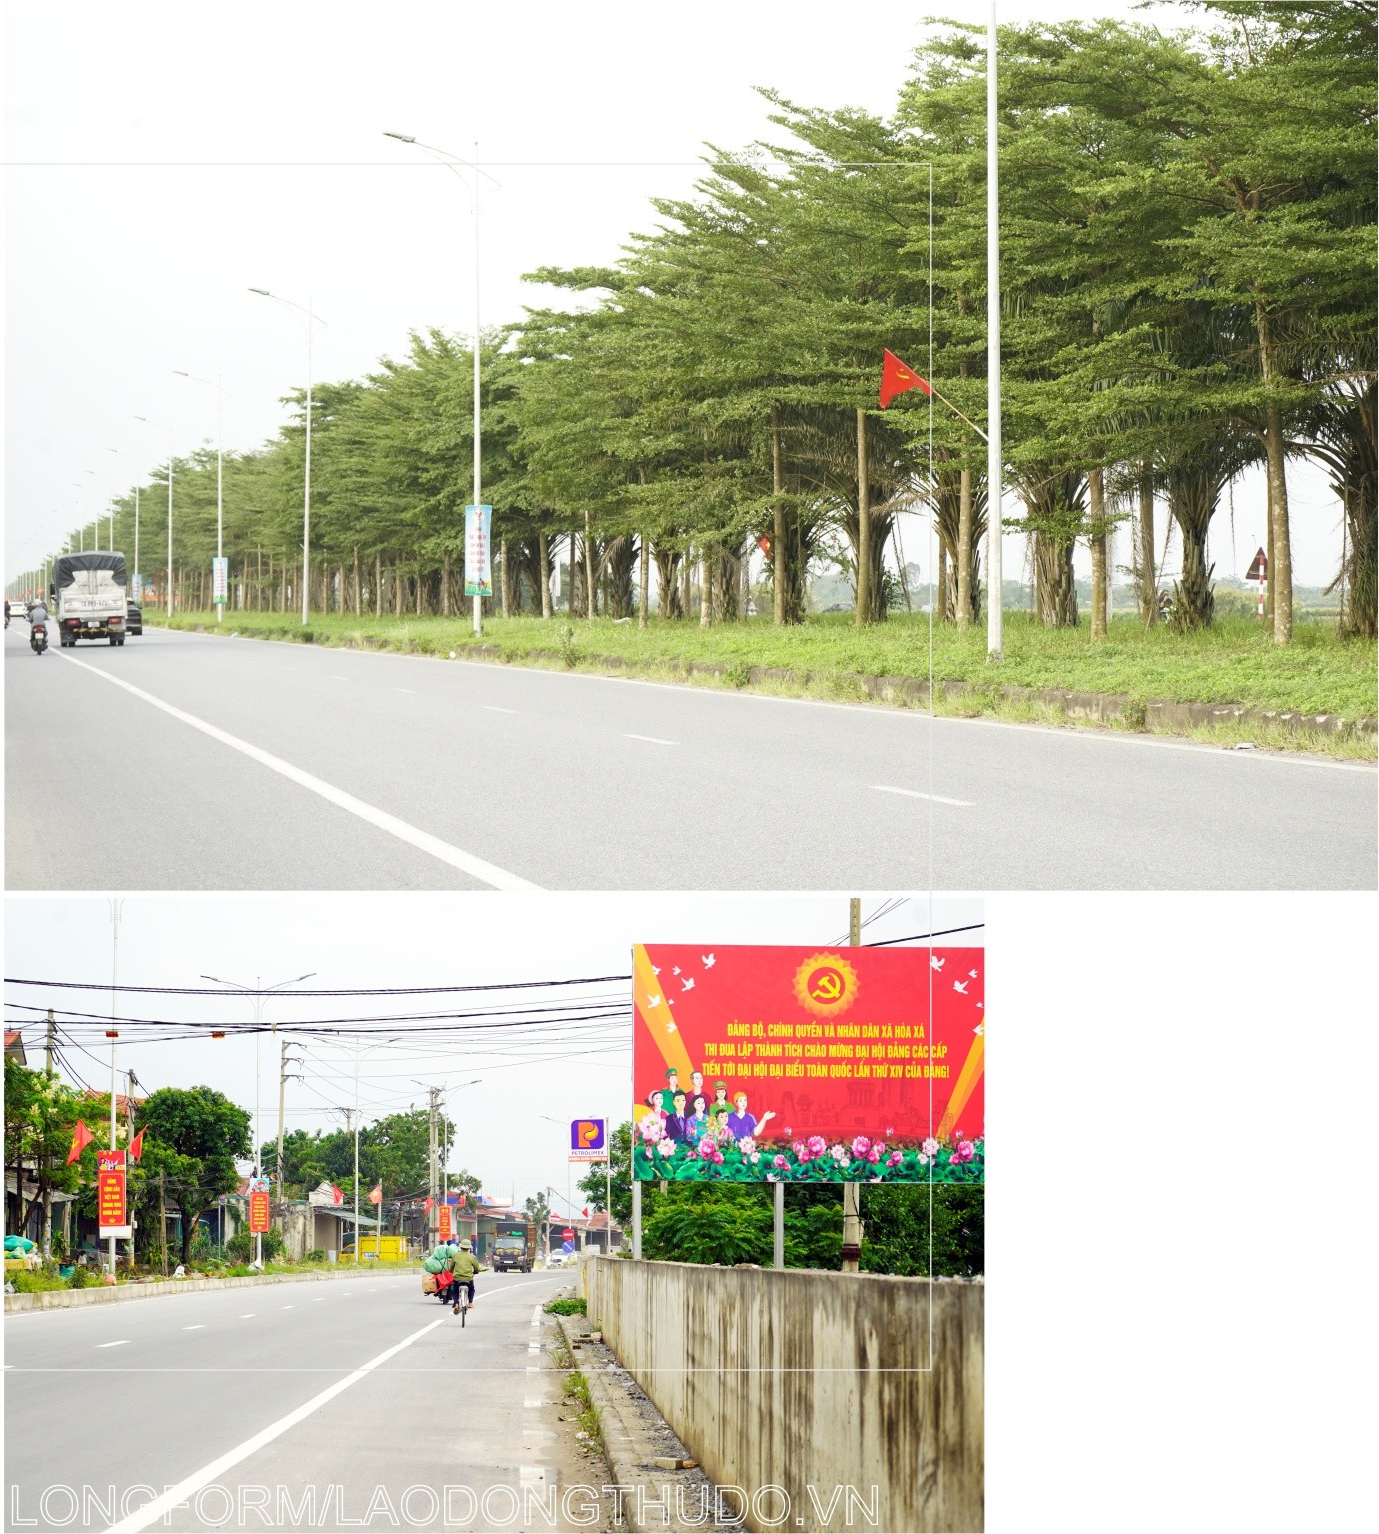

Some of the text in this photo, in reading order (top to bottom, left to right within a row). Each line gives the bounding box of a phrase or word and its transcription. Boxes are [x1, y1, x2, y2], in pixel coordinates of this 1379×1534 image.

[727, 1019, 750, 1036] ĐẢNG
[752, 1021, 766, 1039] BỘ,
[768, 1021, 793, 1037] CHÍNH
[795, 1020, 822, 1038] QUYỀN
[824, 1022, 835, 1037] VÀ
[837, 1022, 860, 1038] NHÂN
[862, 1022, 879, 1038] DÂN
[882, 1022, 893, 1038] XÃ
[895, 1022, 911, 1038] HÒA
[705, 1041, 948, 1061] THI ĐUA LẬP THÀNH TÍCH CHÀO MỪNG ĐẠI HỘI ĐẢNG CÁC CẤP
[702, 1059, 949, 1080] TIẾN TỚI ĐẠI HỘI ĐẠI BIỂU TOÀN QUỐC LẦN THỨ XIV CỦA ĐẢNG!
